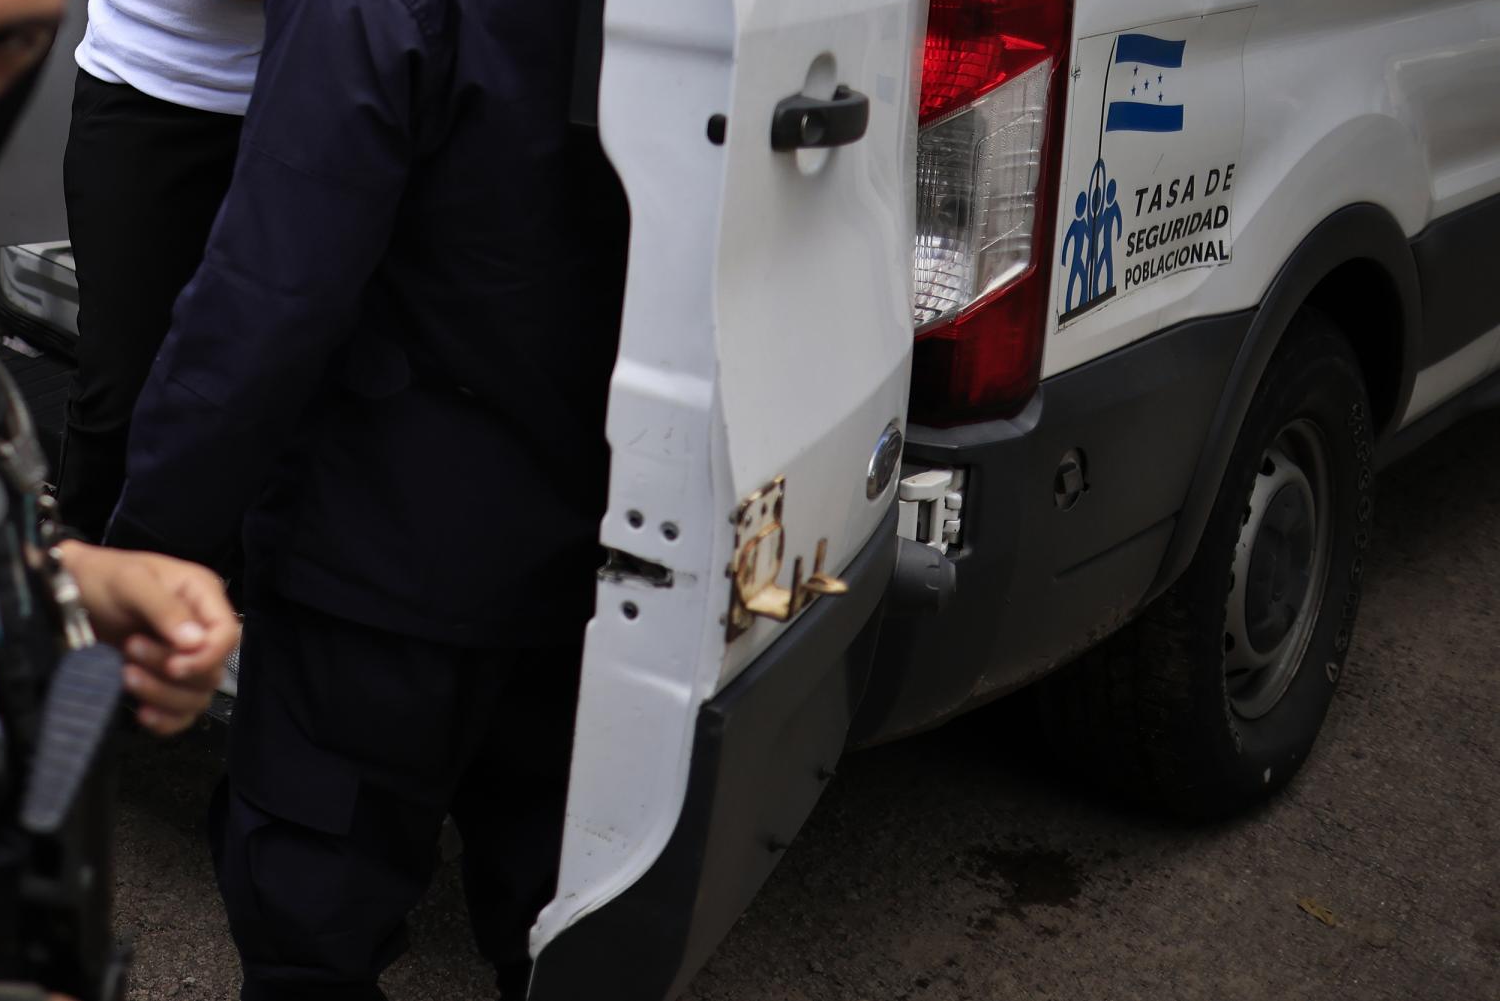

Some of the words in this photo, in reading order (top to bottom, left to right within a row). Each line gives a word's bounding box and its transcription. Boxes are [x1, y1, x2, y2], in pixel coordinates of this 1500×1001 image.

[1135, 174, 1195, 217] TASA
[1204, 163, 1235, 197] DE
[1125, 205, 1229, 257] SEGURIDAD
[1124, 239, 1229, 290] POBLACIONAL
